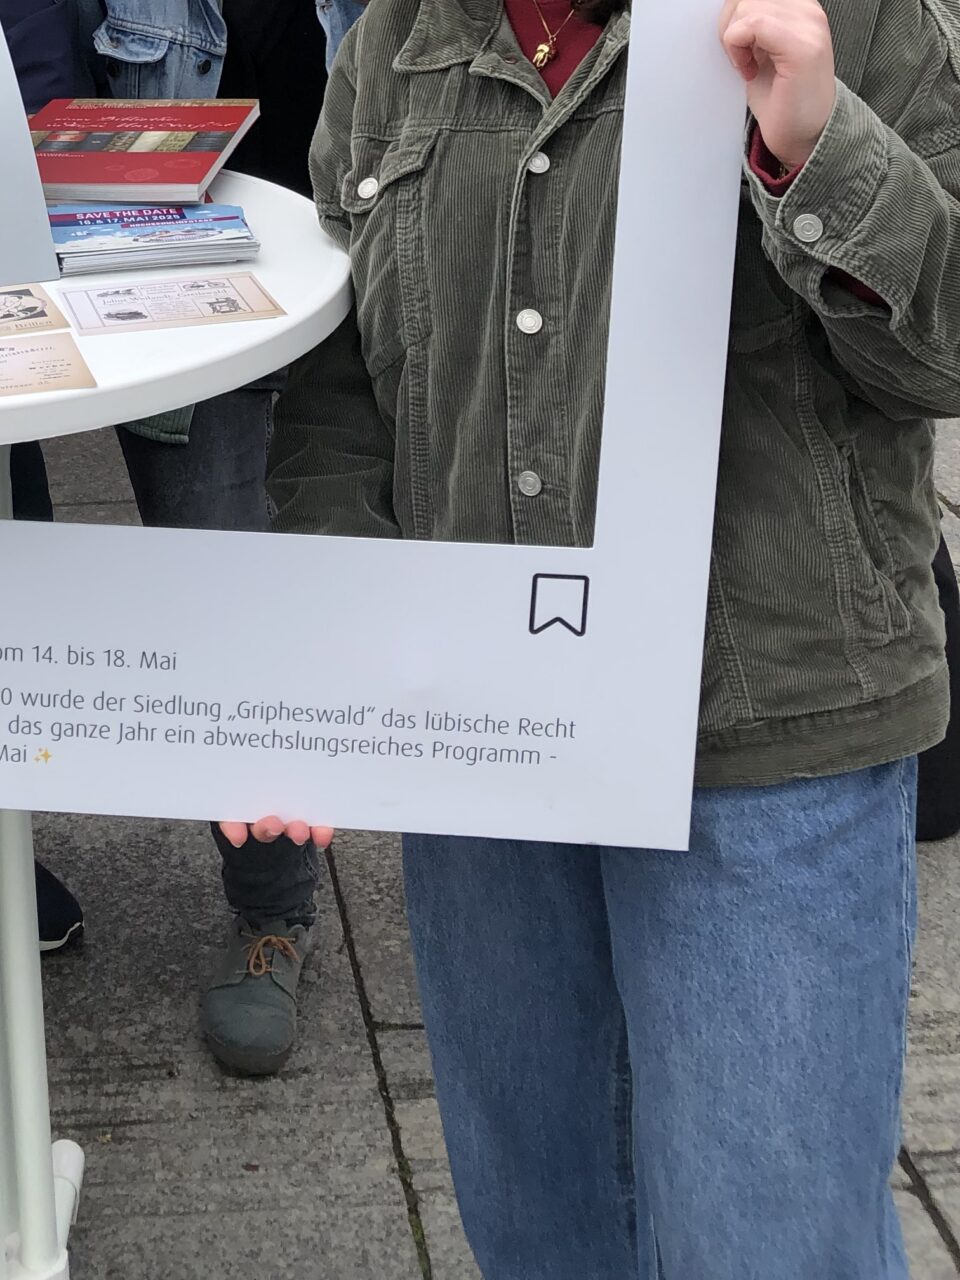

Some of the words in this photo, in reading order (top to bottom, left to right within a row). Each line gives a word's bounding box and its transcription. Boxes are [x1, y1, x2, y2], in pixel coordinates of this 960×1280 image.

[76, 210, 114, 220] SAVE
[116, 208, 143, 218] THE
[145, 207, 177, 217] DATE
[106, 217, 122, 225] 17.
[124, 216, 150, 224] MAI
[152, 214, 180, 222] 2025
[31, 644, 59, 665] 14.
[66, 644, 96, 667] bis
[102, 648, 131, 669] 18.
[139, 650, 177, 671] Mai
[19, 688, 85, 710] wurde
[92, 690, 127, 713] der
[132, 694, 222, 723] Siedlung
[381, 706, 417, 730] das
[424, 710, 510, 736] lübische
[517, 716, 577, 739] Recht
[7, 713, 43, 736] das
[50, 721, 111, 742] ganze
[115, 720, 158, 745] Jahr
[164, 724, 196, 745] ein
[202, 724, 424, 758] abwechslungsreiches
[431, 740, 541, 767] Programm
